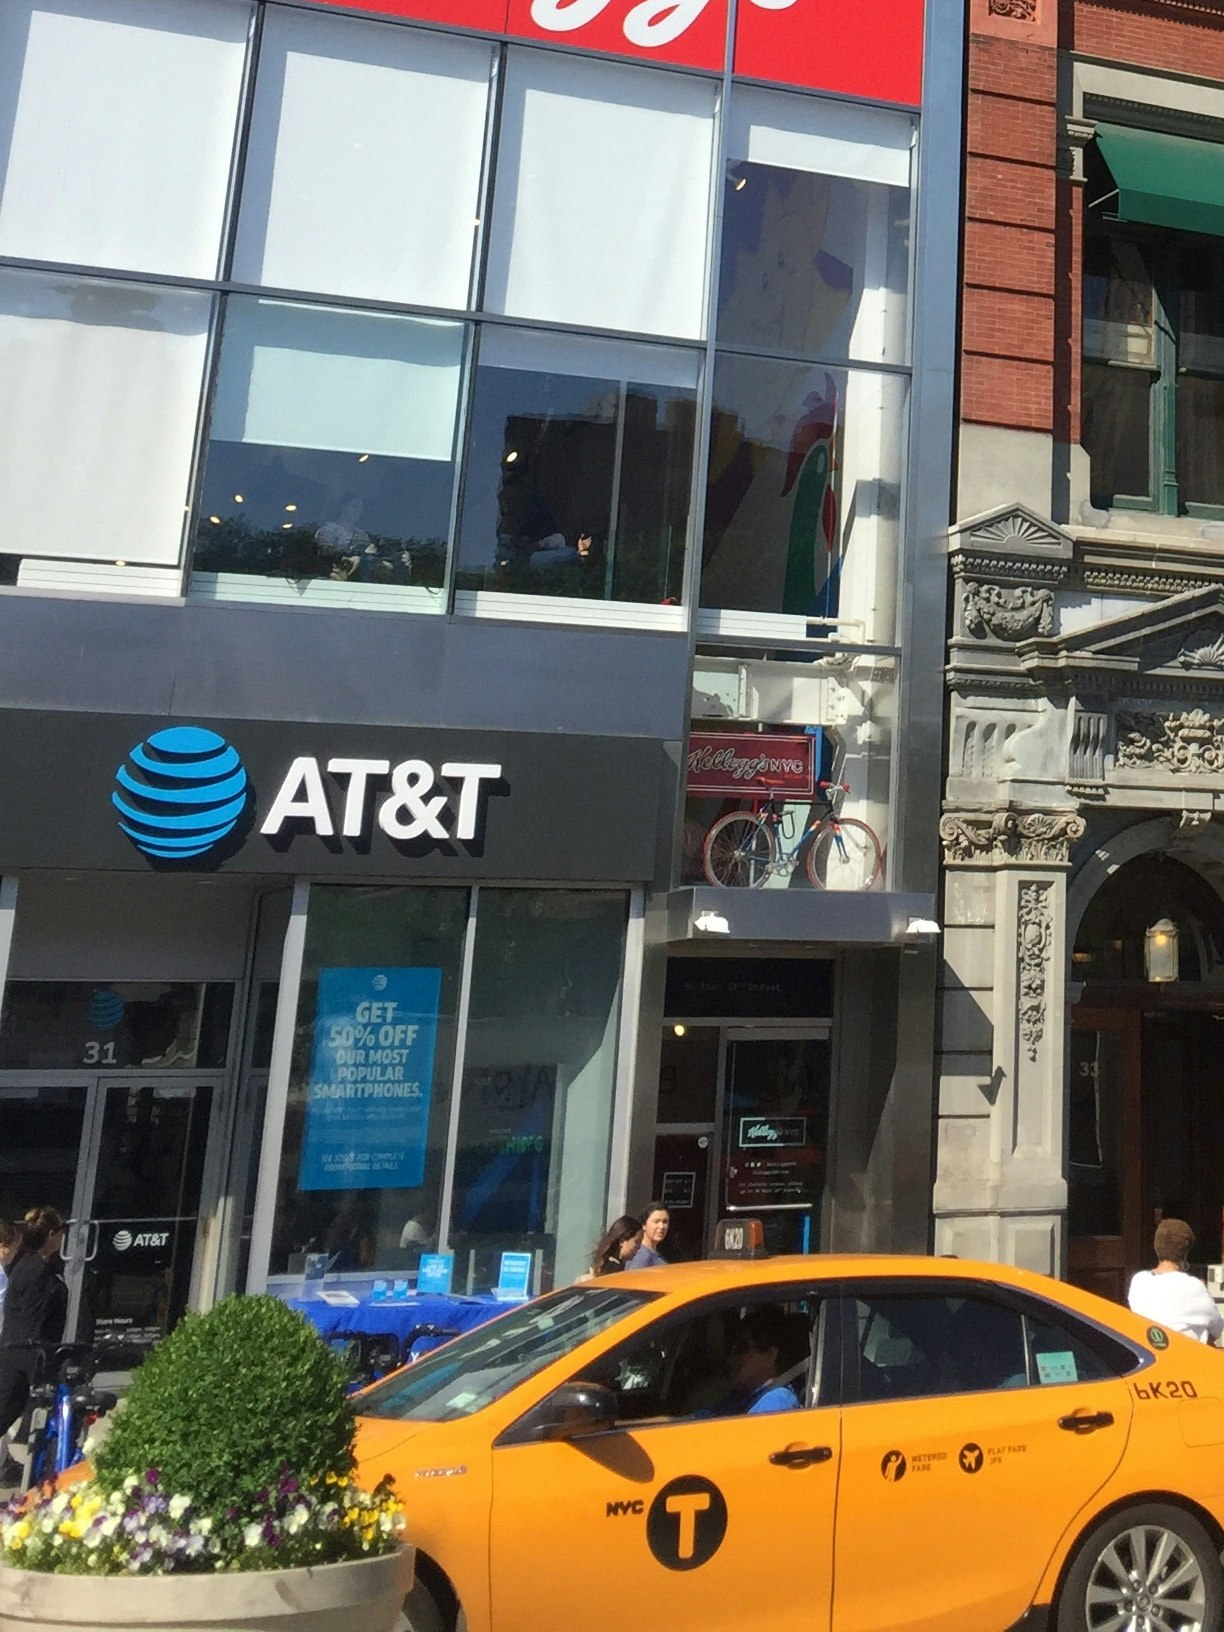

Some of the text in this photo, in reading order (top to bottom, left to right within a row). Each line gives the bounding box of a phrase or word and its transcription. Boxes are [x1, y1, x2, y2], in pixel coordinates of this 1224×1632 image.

[768, 758, 804, 774] NYC
[260, 757, 502, 840] AT&T
[355, 1001, 398, 1024] GET
[328, 1024, 419, 1048] 50% OFF
[83, 1041, 117, 1064] 31
[335, 1049, 410, 1065] OUR MOST
[336, 1066, 404, 1082] POPULAR
[1080, 1061, 1099, 1077] 33
[313, 1082, 424, 1099] SMARTPHONES.
[133, 1233, 170, 1247] AT&T
[725, 1228, 744, 1250] 6K20
[1133, 1380, 1198, 1400] 6K20
[606, 1492, 710, 1559] NYC T
